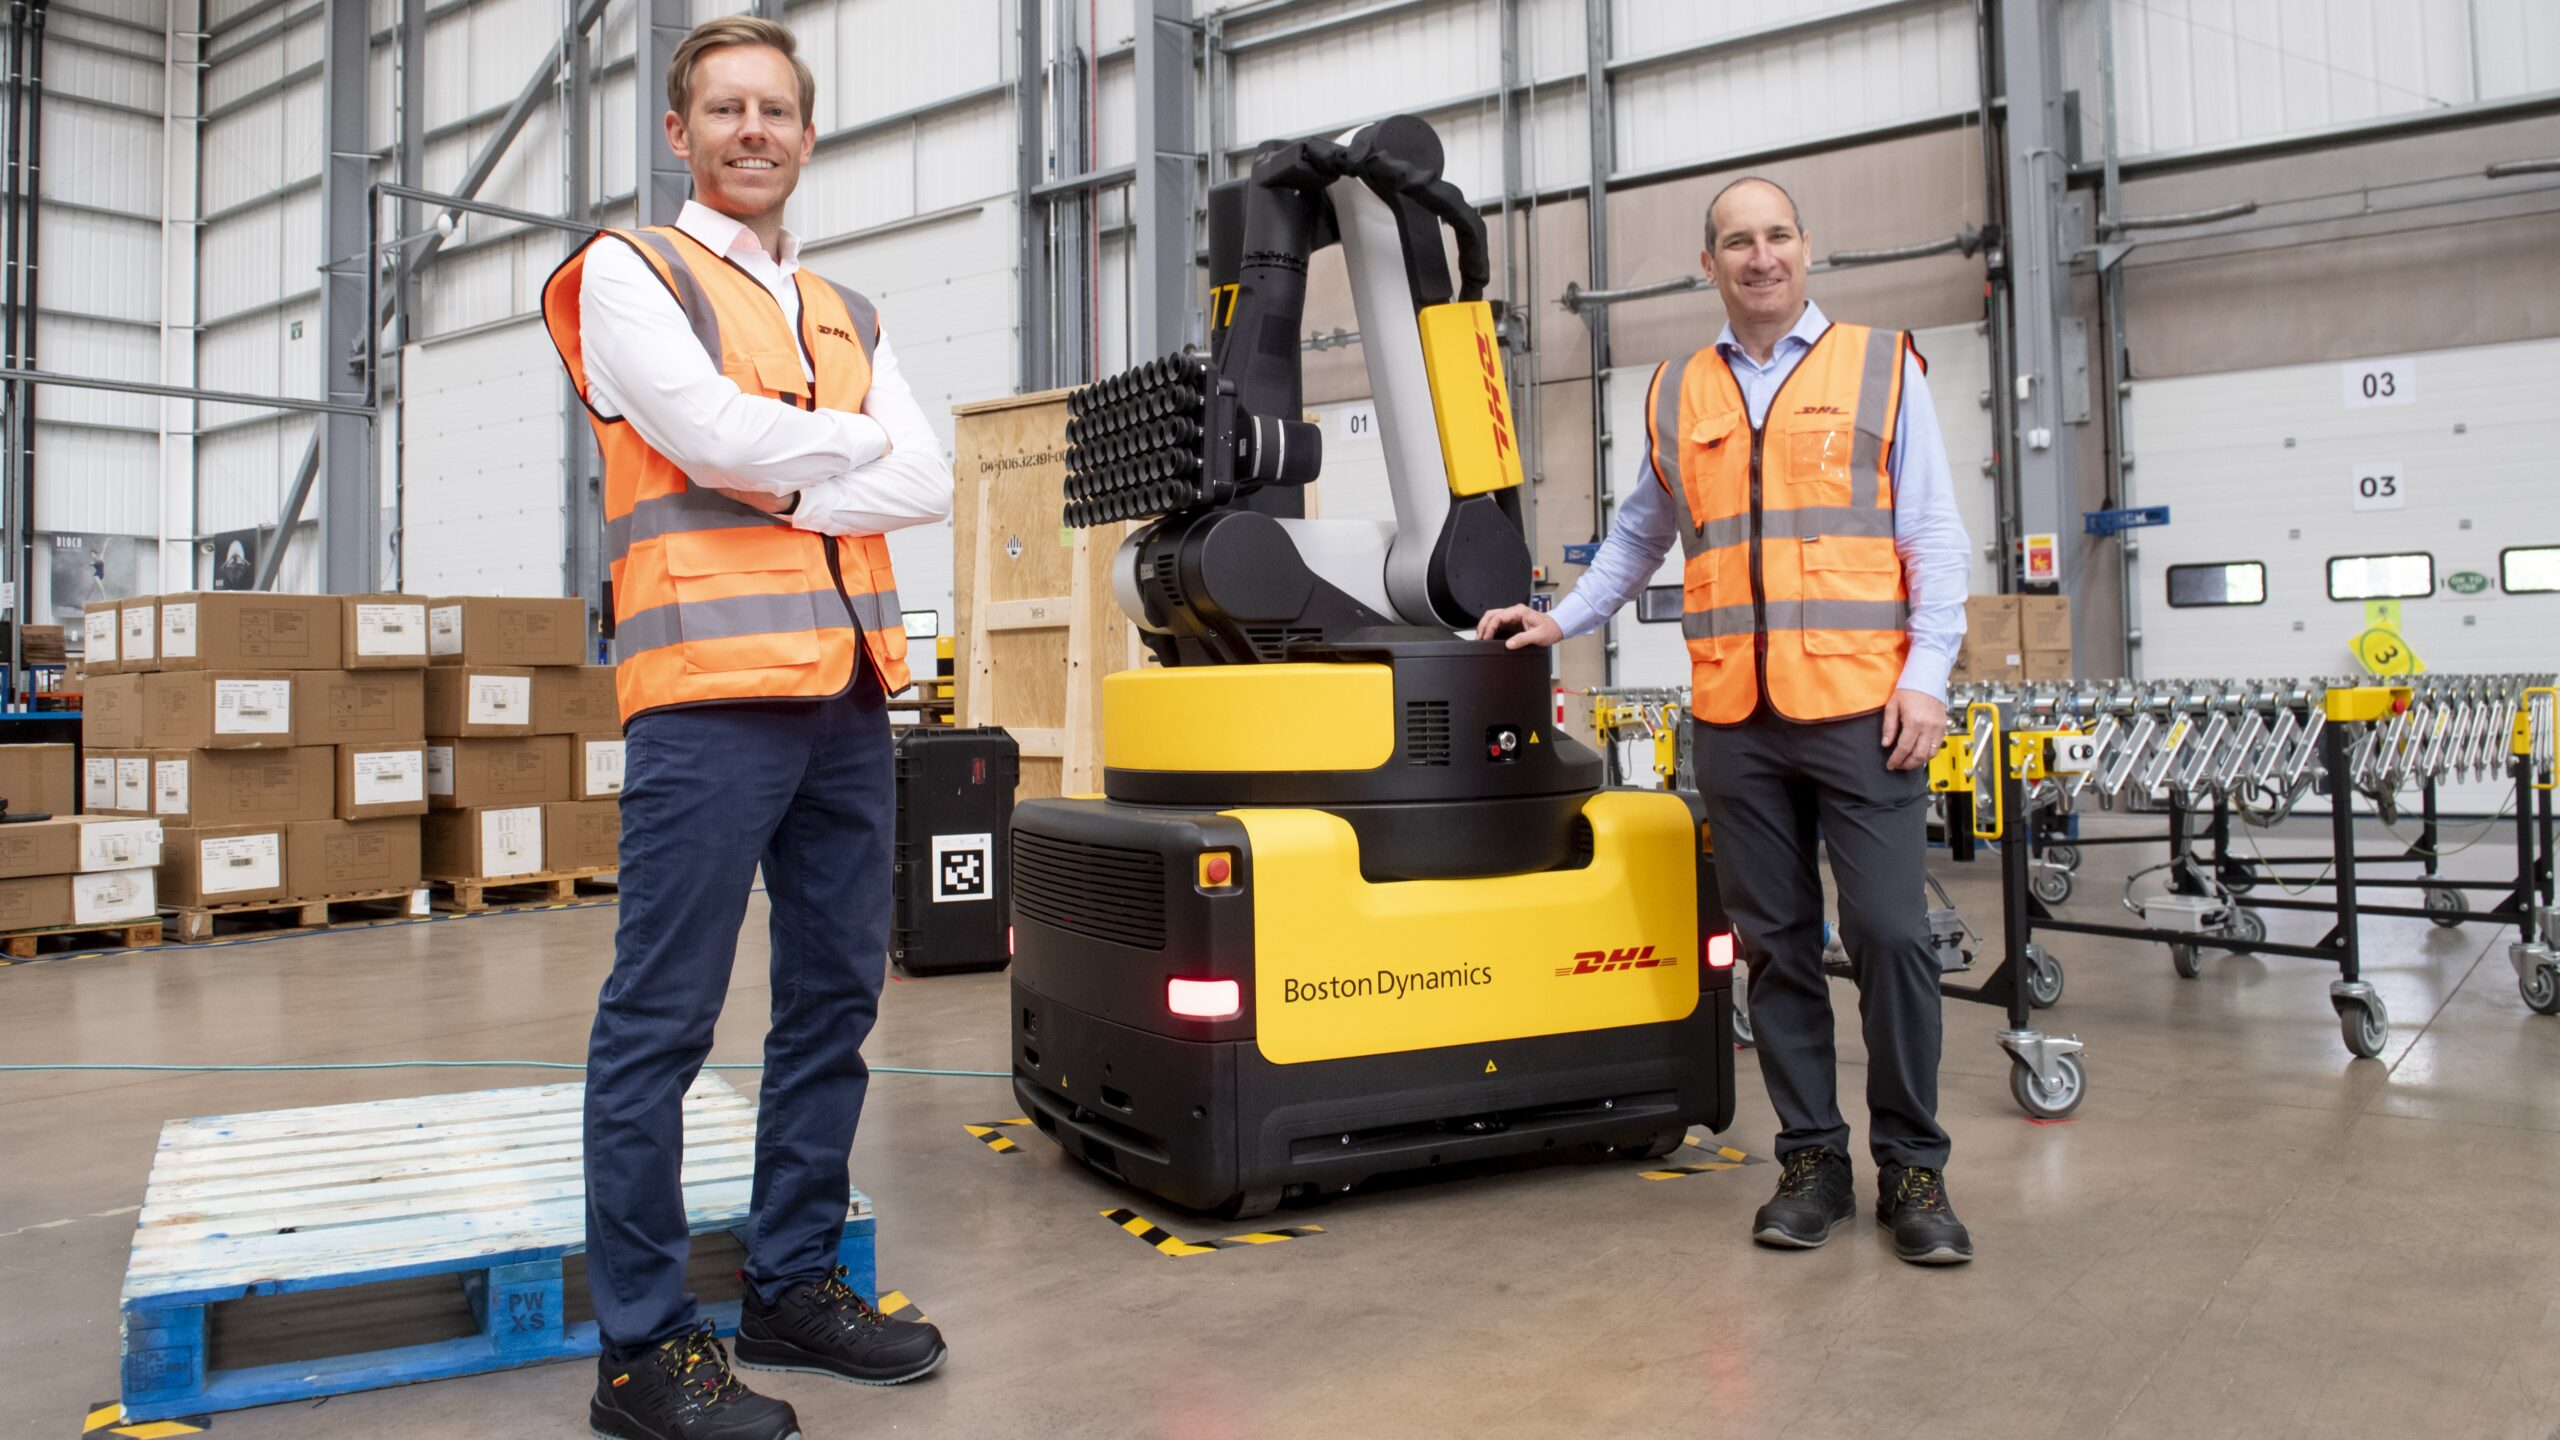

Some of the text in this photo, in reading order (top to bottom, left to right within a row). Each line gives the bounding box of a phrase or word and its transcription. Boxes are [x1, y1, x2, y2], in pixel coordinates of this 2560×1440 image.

[818, 325, 851, 341] DHL
[2363, 371, 2395, 398] 03
[1475, 331, 1510, 461] DHL
[1351, 414, 1367, 433] 01
[2360, 476, 2396, 498] 03
[2374, 645, 2398, 665] 3
[1572, 945, 1661, 975] DHL
[1285, 962, 1492, 1003] Boston Dynamics
[509, 1291, 545, 1312] PW
[511, 1312, 545, 1333] XS
